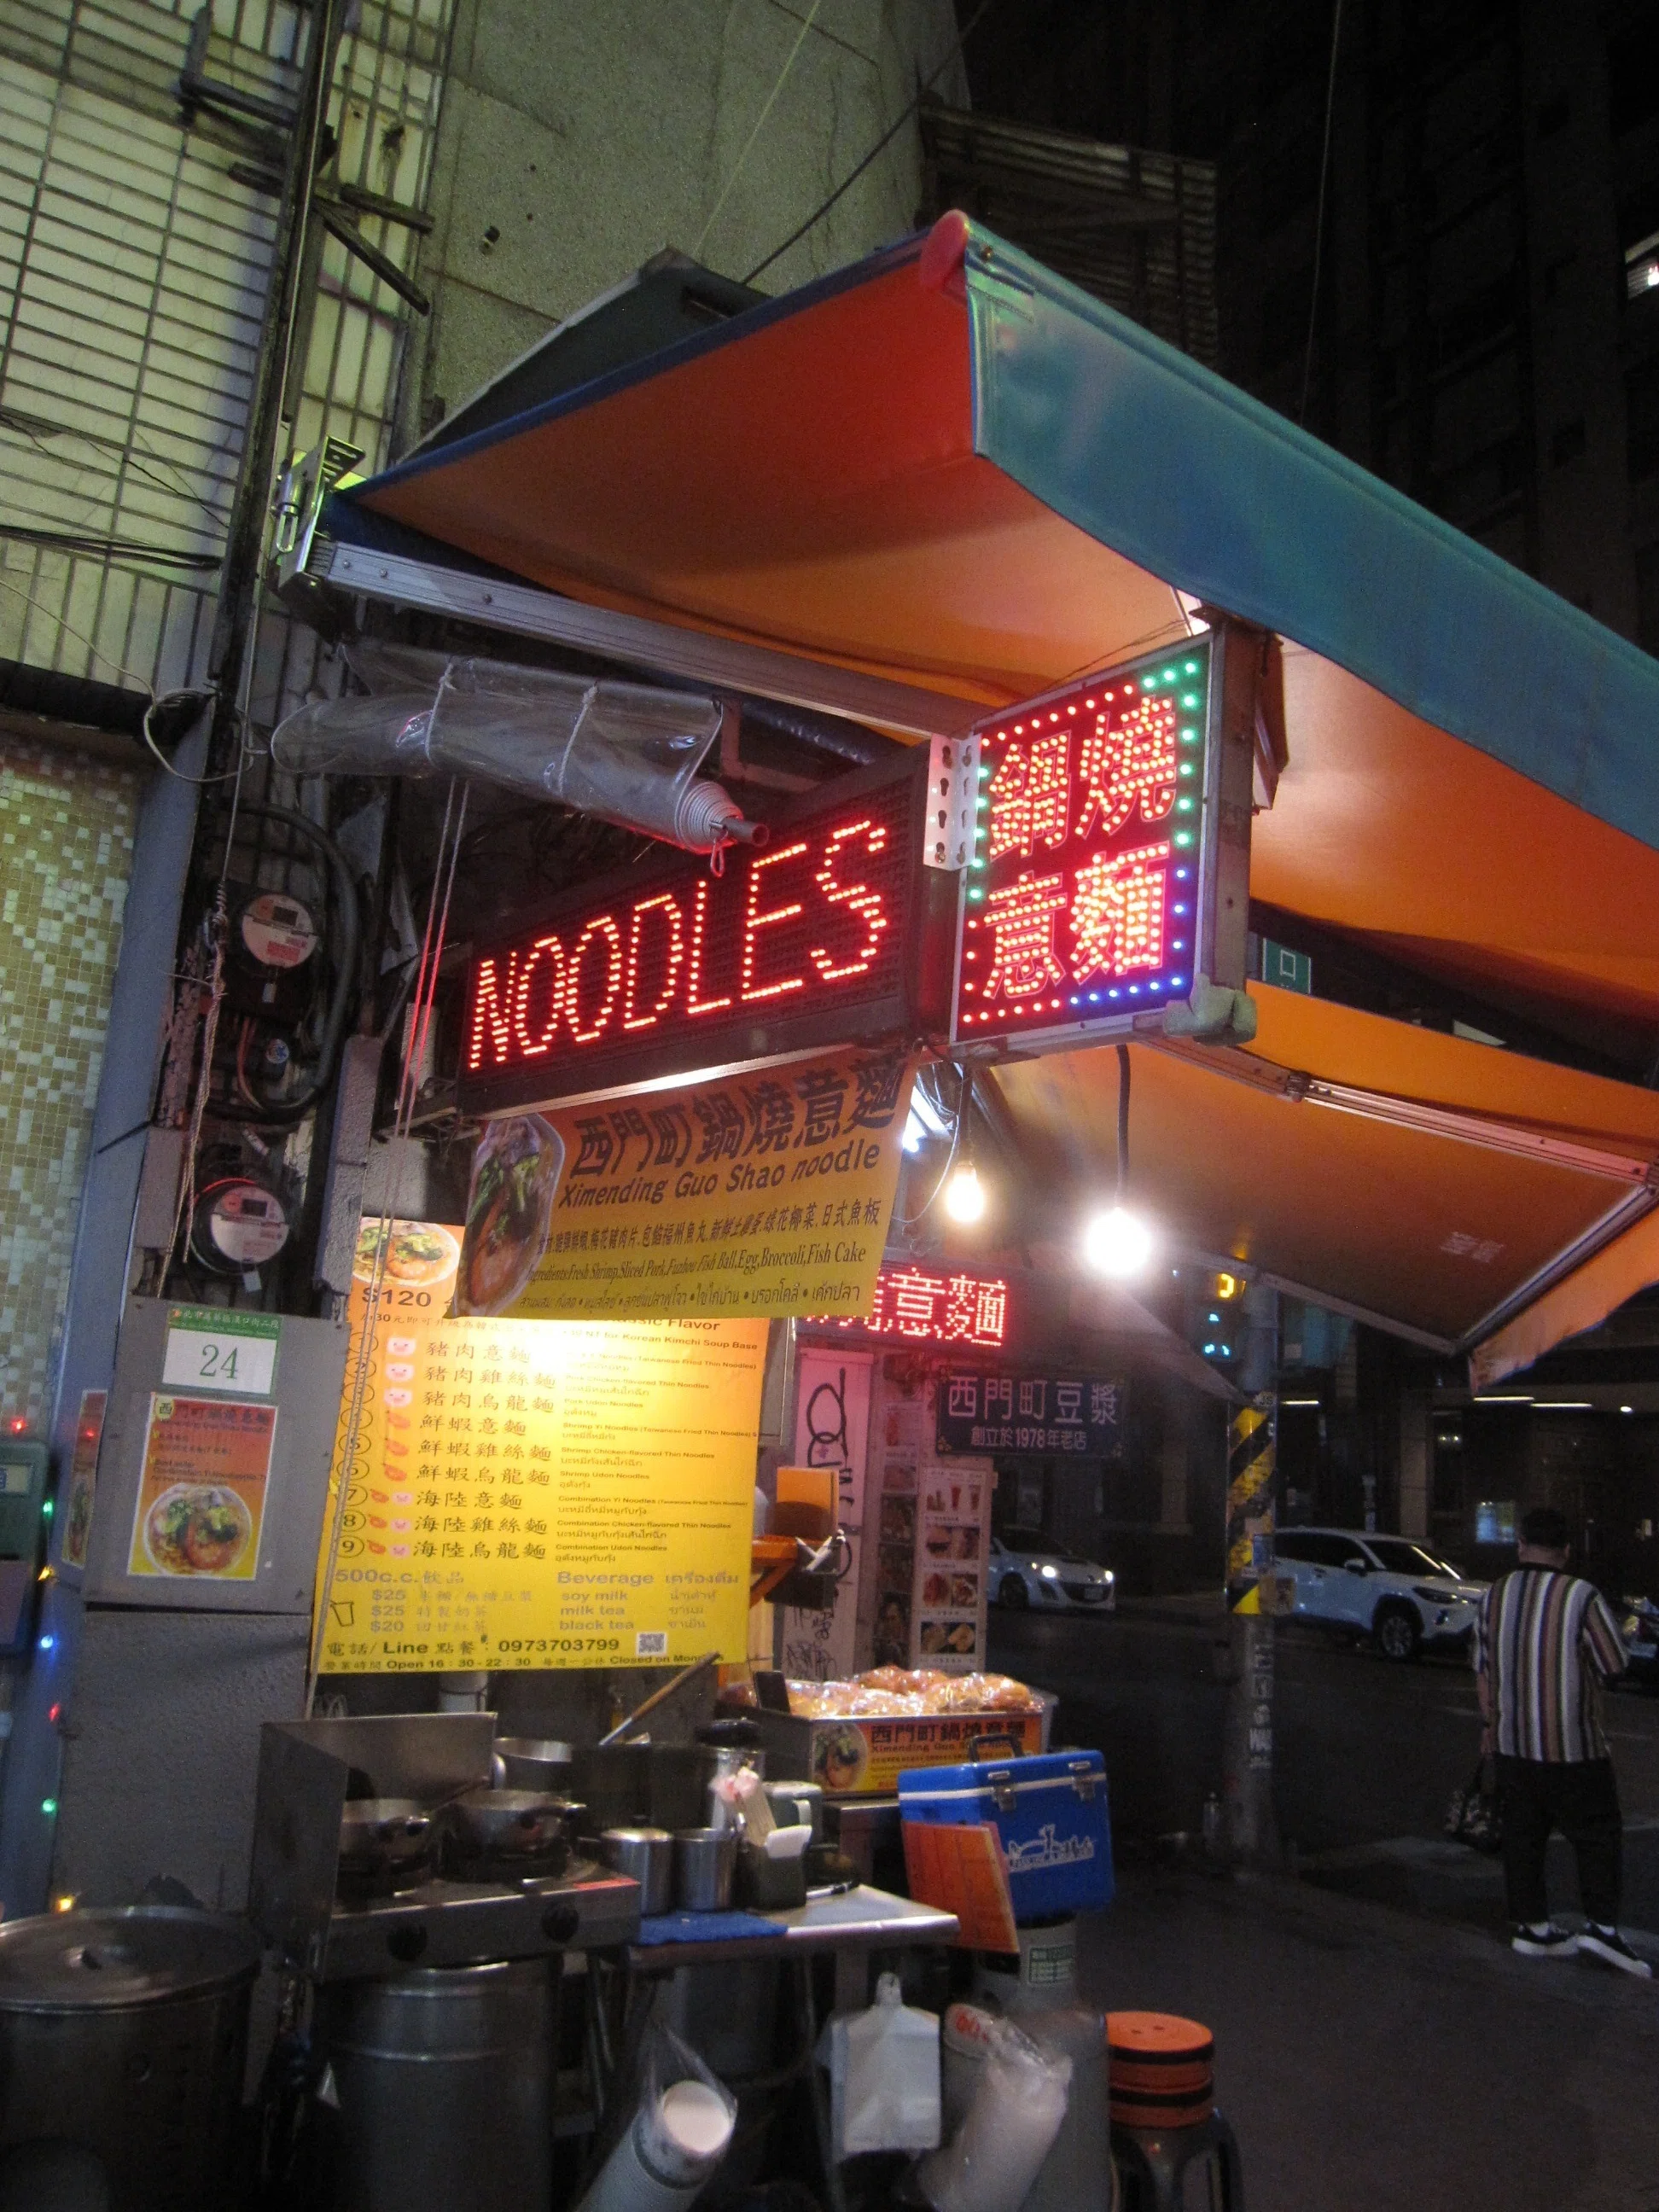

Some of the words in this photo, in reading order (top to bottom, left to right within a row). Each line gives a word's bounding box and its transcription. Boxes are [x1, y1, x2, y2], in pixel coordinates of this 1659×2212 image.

[989, 695, 1178, 859] 鍋燒
[982, 841, 1171, 1002] 意麵
[469, 820, 888, 1070] NOODLES
[569, 1055, 906, 1179] 西門町鍋燒意麵
[558, 1177, 667, 1209] Ximending
[673, 1170, 719, 1198] Guo
[725, 1160, 785, 1191] Shao
[791, 1138, 880, 1184] noodle
[696, 1254, 716, 1272] Fish
[835, 1241, 866, 1263] Cake
[361, 1287, 432, 1307] $120
[668, 1318, 721, 1331] Flavor
[665, 1336, 701, 1347] Kimchi
[704, 1339, 730, 1349] Soup
[732, 1342, 758, 1351] Base
[199, 1343, 239, 1380] 24
[948, 1376, 1117, 1425] 西門町豆漿
[419, 1414, 527, 1436] 鮮蝦意麵
[418, 1440, 552, 1462] 鮮蝦雞絲麵
[416, 1488, 522, 1511] 海陸意麵
[414, 1515, 548, 1535] 海陸雞絲麵
[557, 1570, 655, 1587] Beverage
[372, 1589, 406, 1601] $25
[561, 1591, 590, 1601] soy
[595, 1588, 628, 1601] milk
[371, 1604, 405, 1616] $25
[560, 1604, 595, 1615] milk
[599, 1605, 626, 1615] tea
[370, 1621, 405, 1633] $20
[559, 1620, 605, 1630] black
[608, 1621, 635, 1631] tea
[383, 1641, 428, 1655] Line
[498, 1639, 620, 1652] 0973703799
[386, 1658, 424, 1670] Open
[609, 1654, 655, 1665] Closed
[655, 1656, 670, 1664] on
